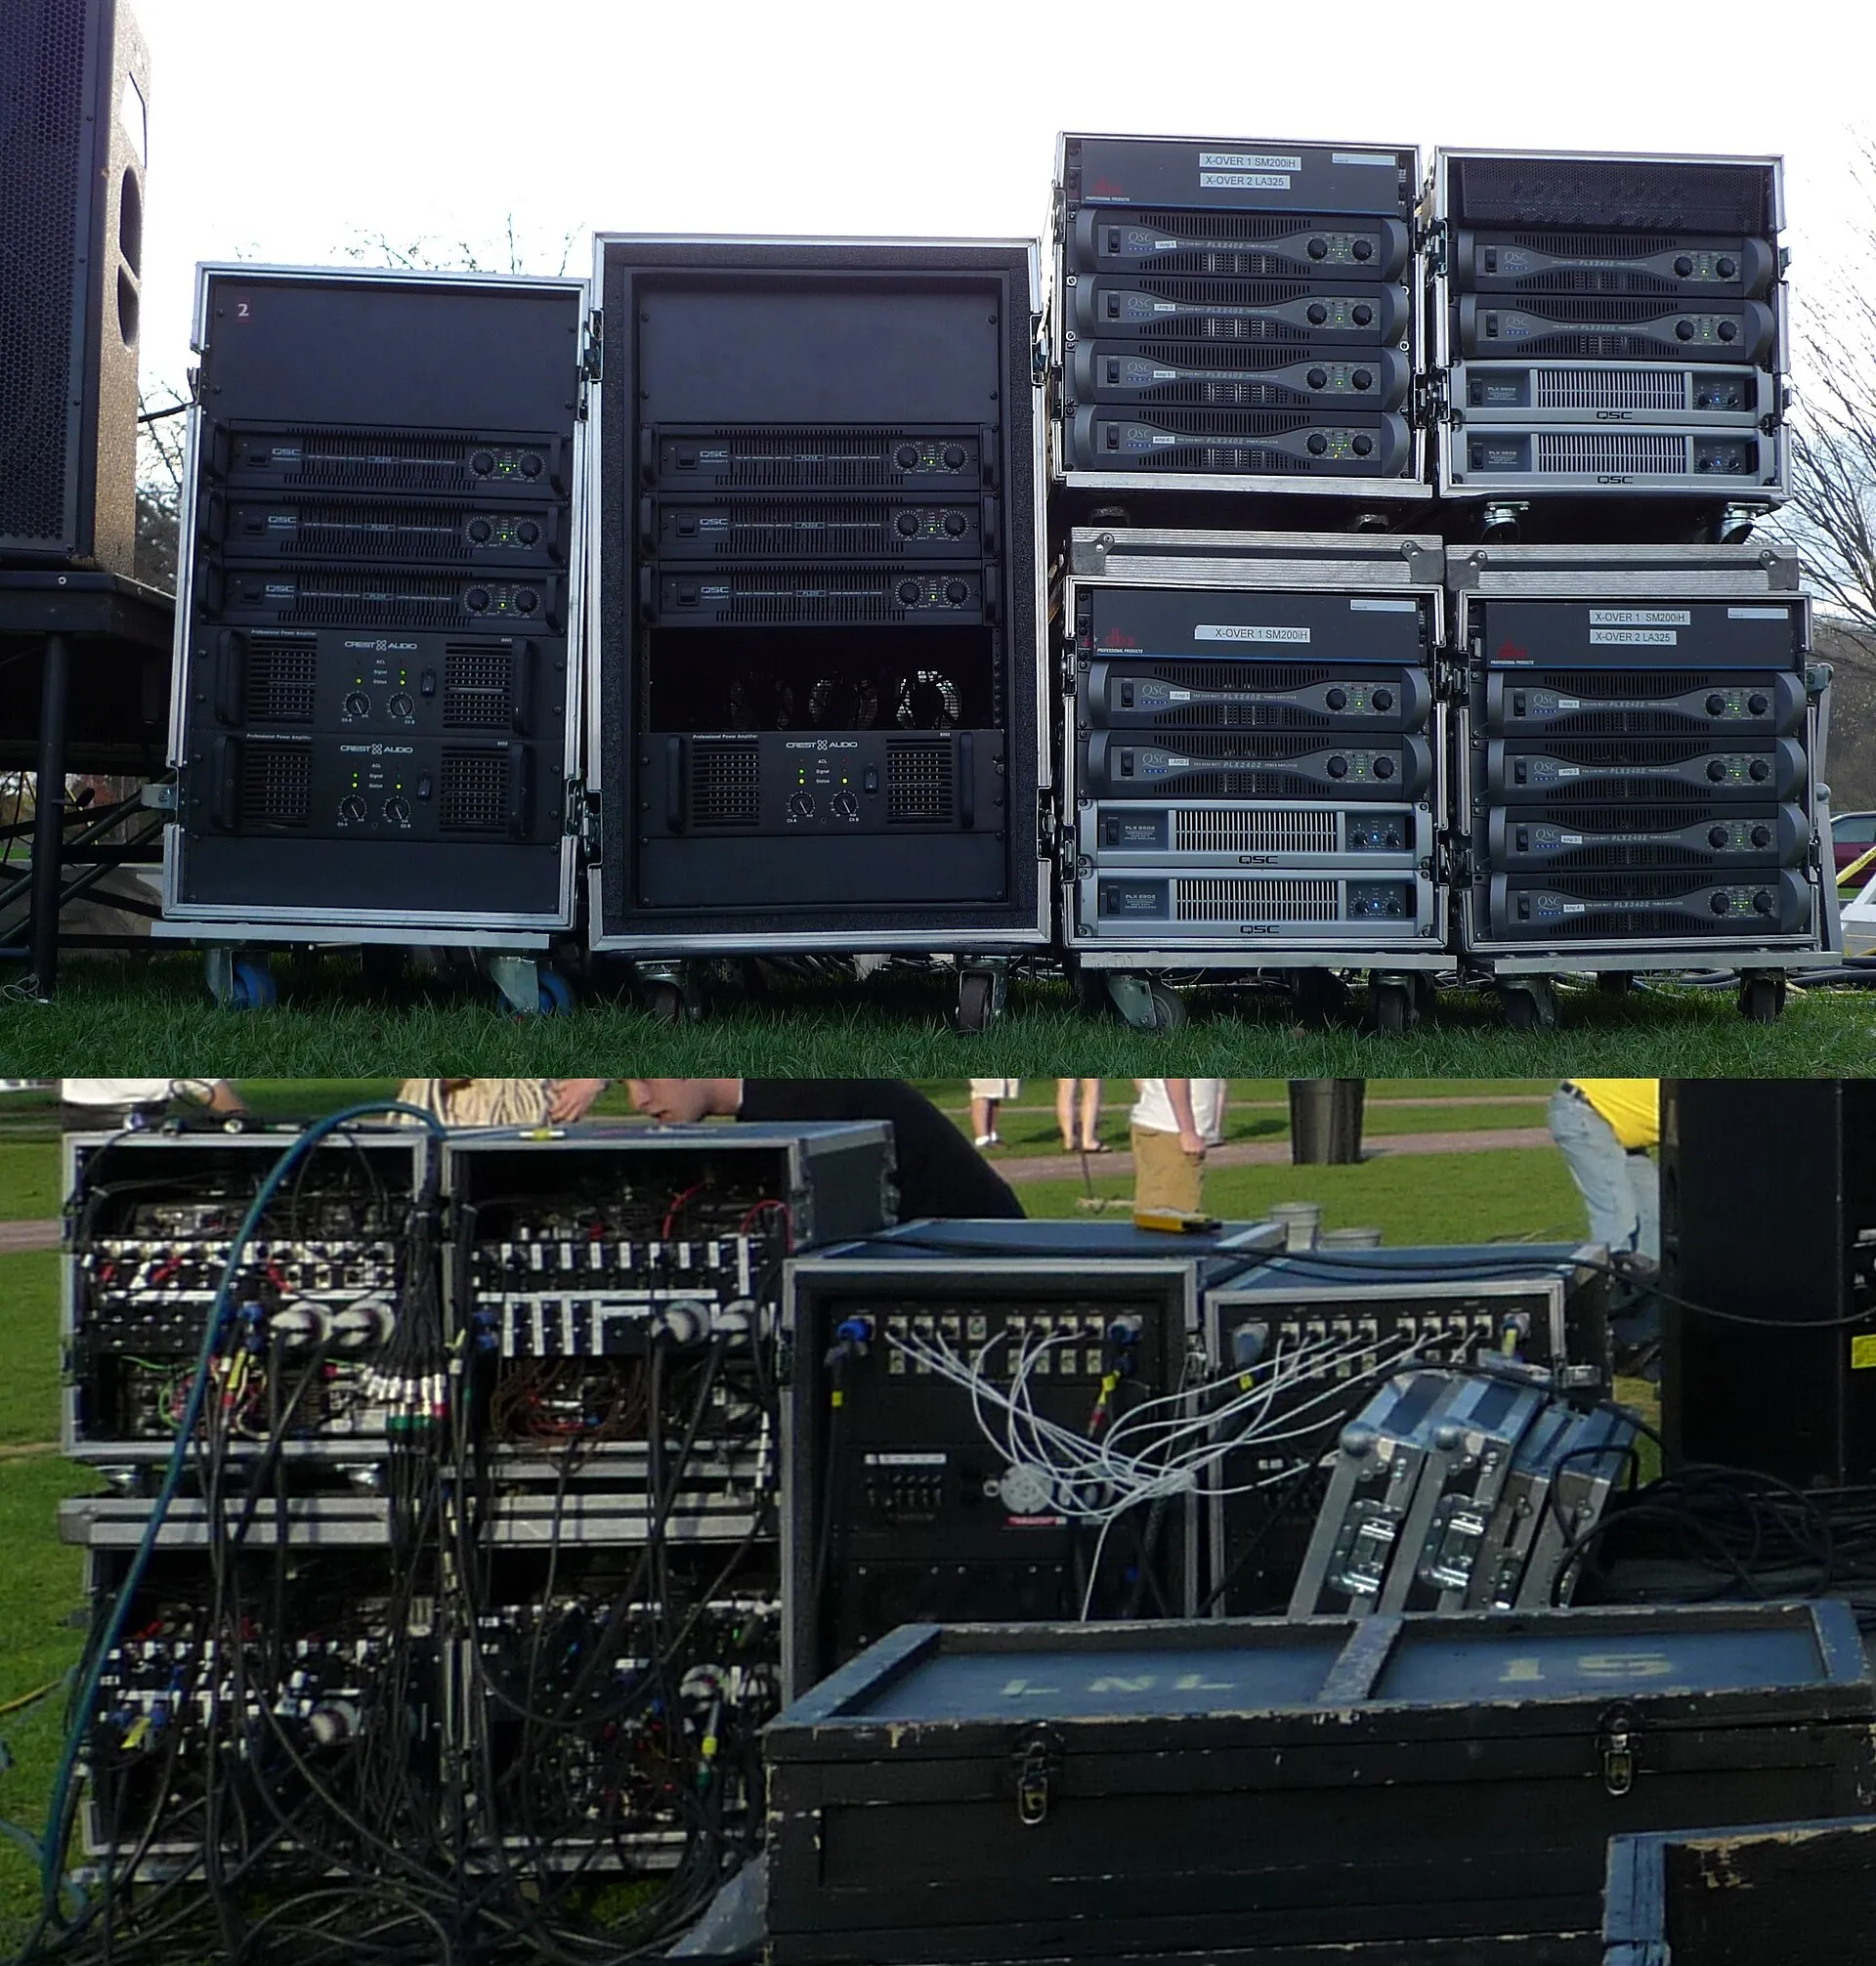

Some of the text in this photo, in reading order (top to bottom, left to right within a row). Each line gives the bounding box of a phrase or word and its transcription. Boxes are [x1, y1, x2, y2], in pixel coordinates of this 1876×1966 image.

[1205, 156, 1244, 166] X-OVER
[1247, 157, 1251, 166] 1
[1206, 176, 1284, 187] X-OVER 2 LA325
[1129, 232, 1152, 245] QSC
[1505, 252, 1528, 265] QSC
[238, 303, 249, 317] 2
[1128, 297, 1151, 311] QSC
[1505, 316, 1529, 329] QSC
[1128, 363, 1151, 376] QSC
[1597, 411, 1632, 420] QSC
[1127, 428, 1151, 441] QSC
[1597, 476, 1633, 484] QSC
[1595, 613, 1633, 622] X-OVER
[1636, 613, 1640, 622] 1
[1215, 628, 1307, 640] X-OVER 1 SM200iH
[1596, 633, 1670, 642] X-OVER 2 LA325
[1142, 684, 1168, 698] QSC
[1534, 694, 1556, 707] QSC
[1142, 753, 1167, 767] QSC
[1534, 762, 1557, 775] QSC
[1536, 829, 1559, 842] QSC
[1239, 855, 1278, 864] QSC
[1538, 896, 1561, 910] QSC
[1240, 925, 1280, 934] QSC
[1498, 1654, 1673, 1681] 15
